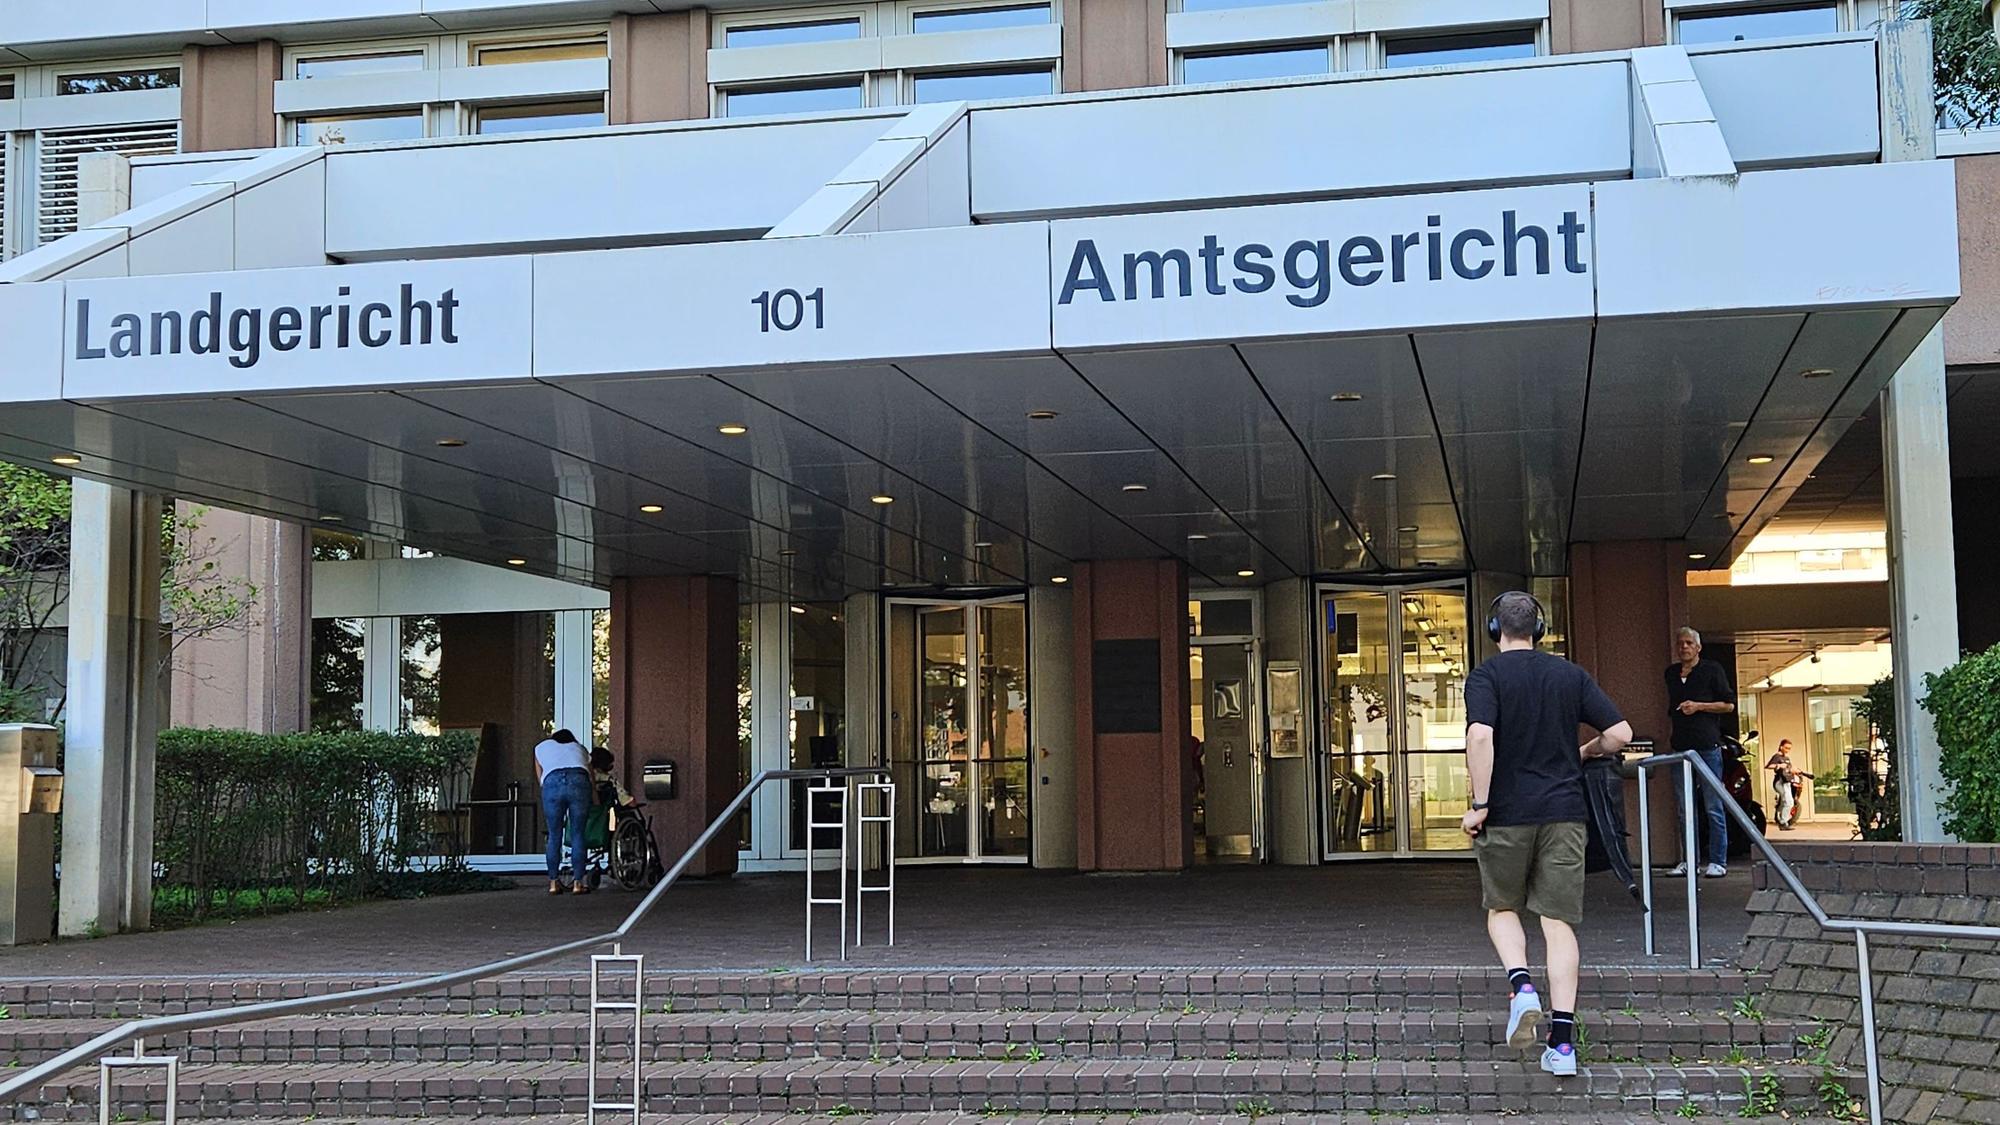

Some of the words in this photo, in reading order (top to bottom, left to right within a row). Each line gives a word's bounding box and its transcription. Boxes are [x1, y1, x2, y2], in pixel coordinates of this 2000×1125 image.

[1057, 209, 1588, 308] Amtsgericht
[75, 283, 460, 369] Landgericht
[751, 287, 824, 333] 101
